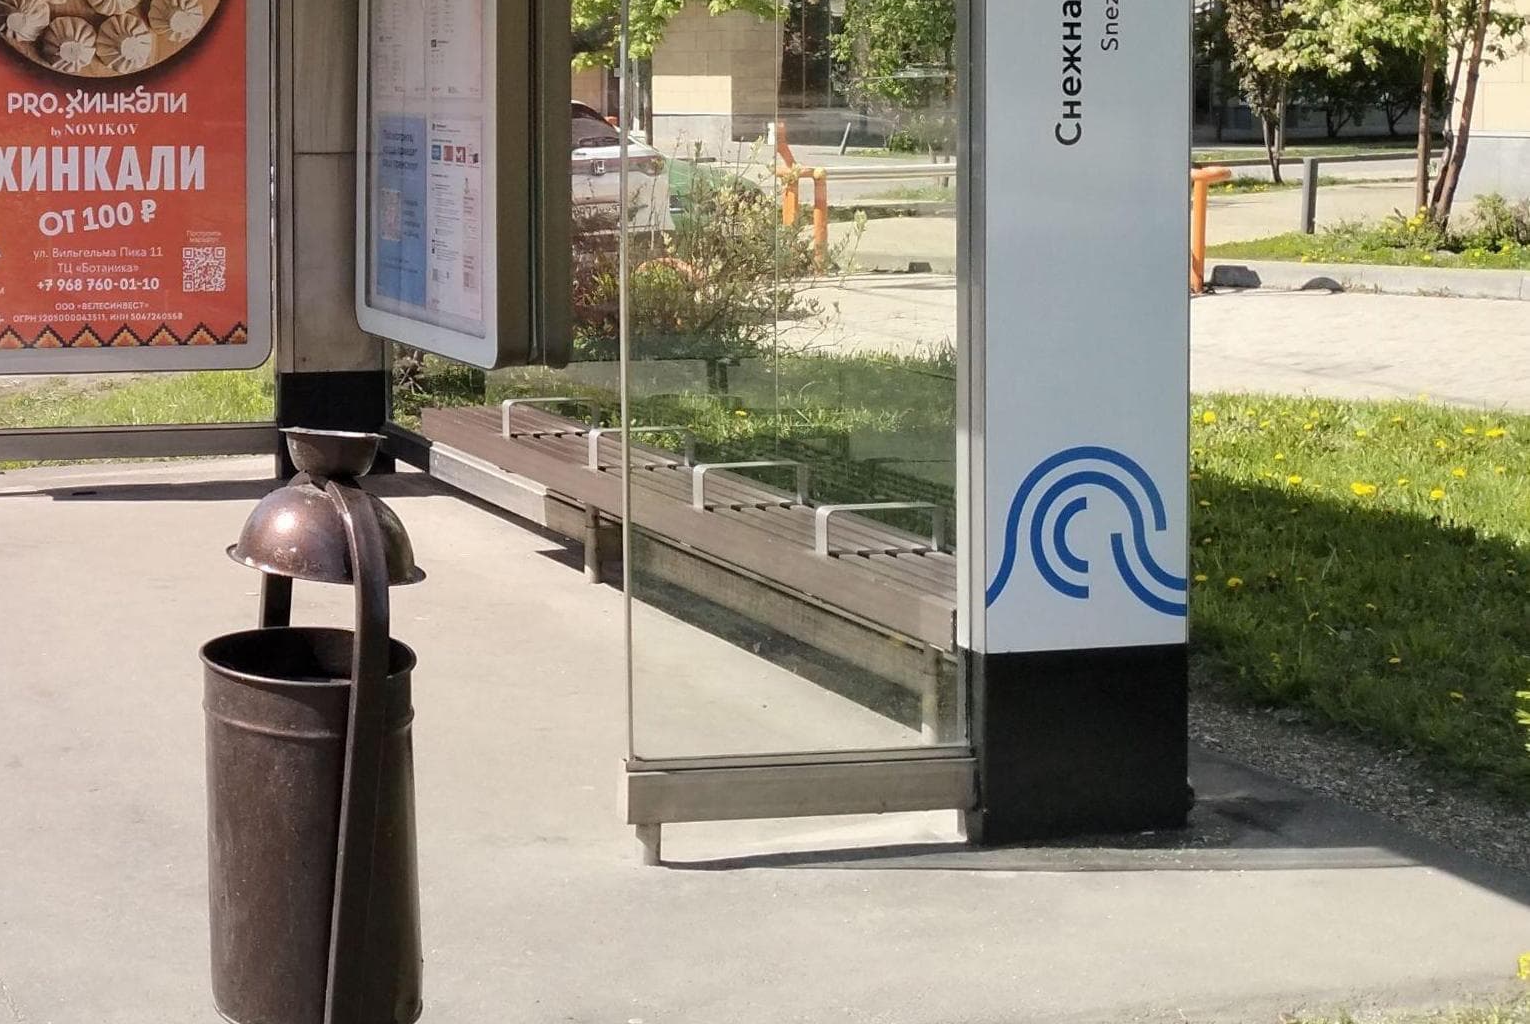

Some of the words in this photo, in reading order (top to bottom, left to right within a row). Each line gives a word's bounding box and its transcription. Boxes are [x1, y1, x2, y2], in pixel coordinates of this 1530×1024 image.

[51, 126, 62, 137] by
[65, 123, 139, 136] NOVIKOV
[38, 209, 75, 236] ОТ
[82, 201, 134, 231] 100
[33, 248, 49, 261] ул.
[52, 247, 117, 258] Вильгельма
[120, 246, 147, 257] Пика
[150, 246, 163, 257] 11
[57, 263, 72, 274] ТЦ
[76, 262, 140, 273] «Ботаника»
[36, 279, 53, 291] +7
[56, 279, 83, 291] 968
[86, 278, 160, 291] 760-01-10
[55, 302, 75, 311] ООО
